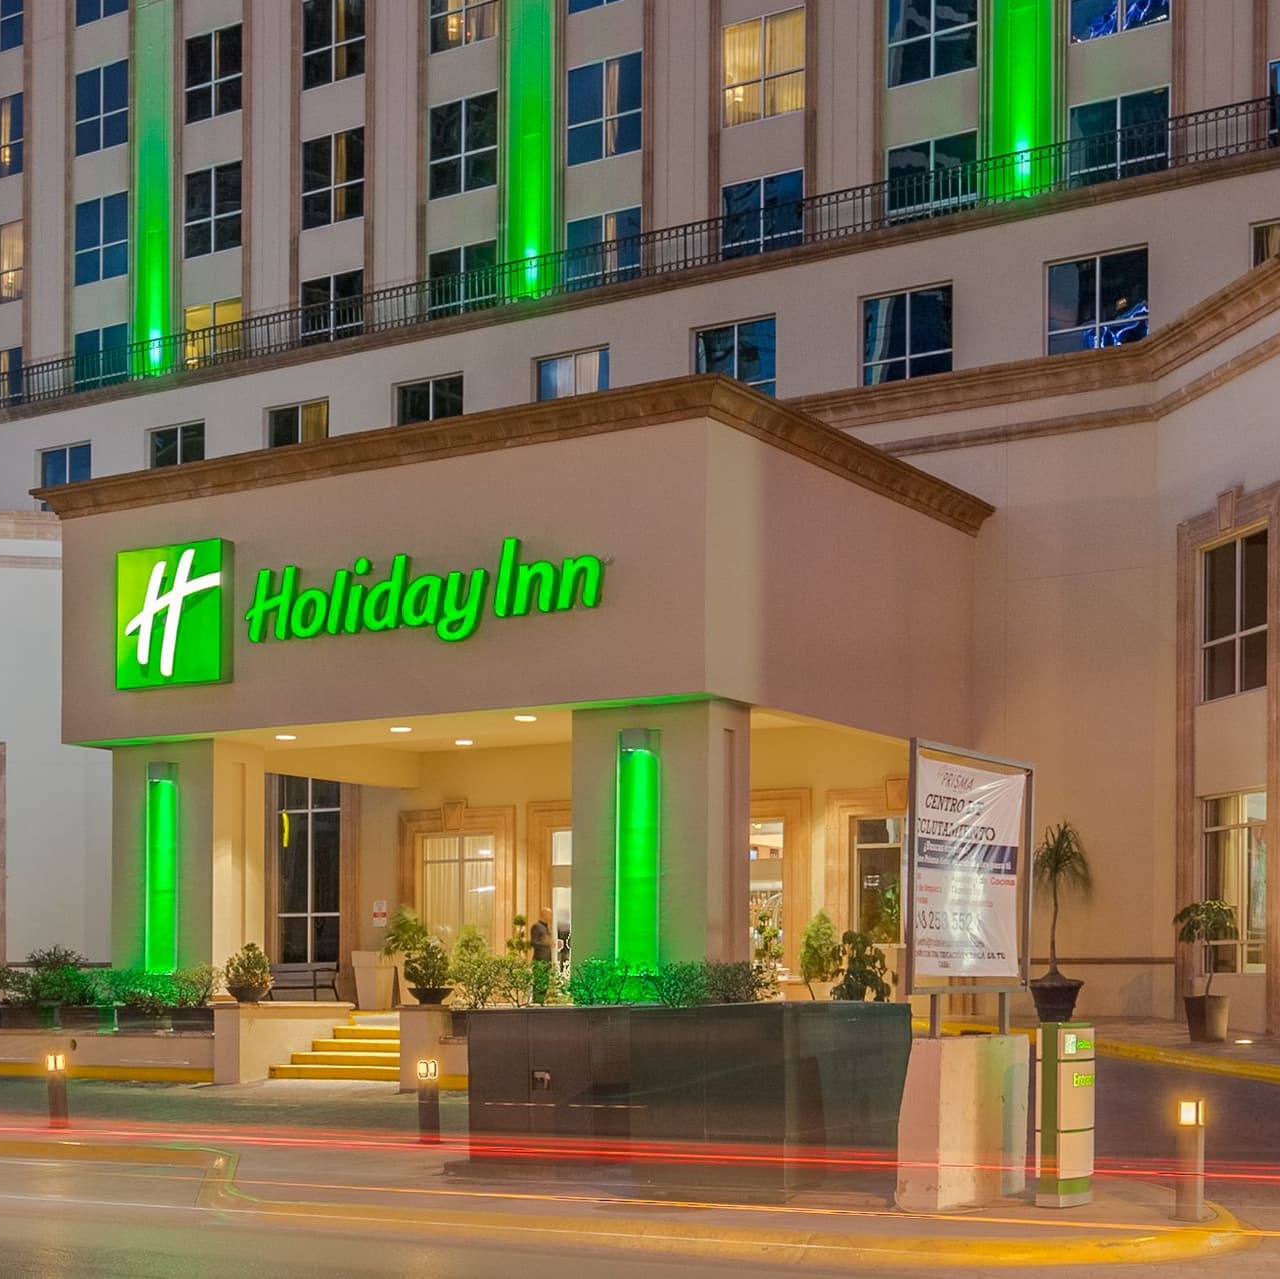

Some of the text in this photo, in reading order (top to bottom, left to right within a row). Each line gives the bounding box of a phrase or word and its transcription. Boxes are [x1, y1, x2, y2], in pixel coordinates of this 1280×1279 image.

[245, 537, 603, 643] Holiday Inn
[942, 772, 974, 790] PRISMA
[925, 793, 965, 813] CENTRO
